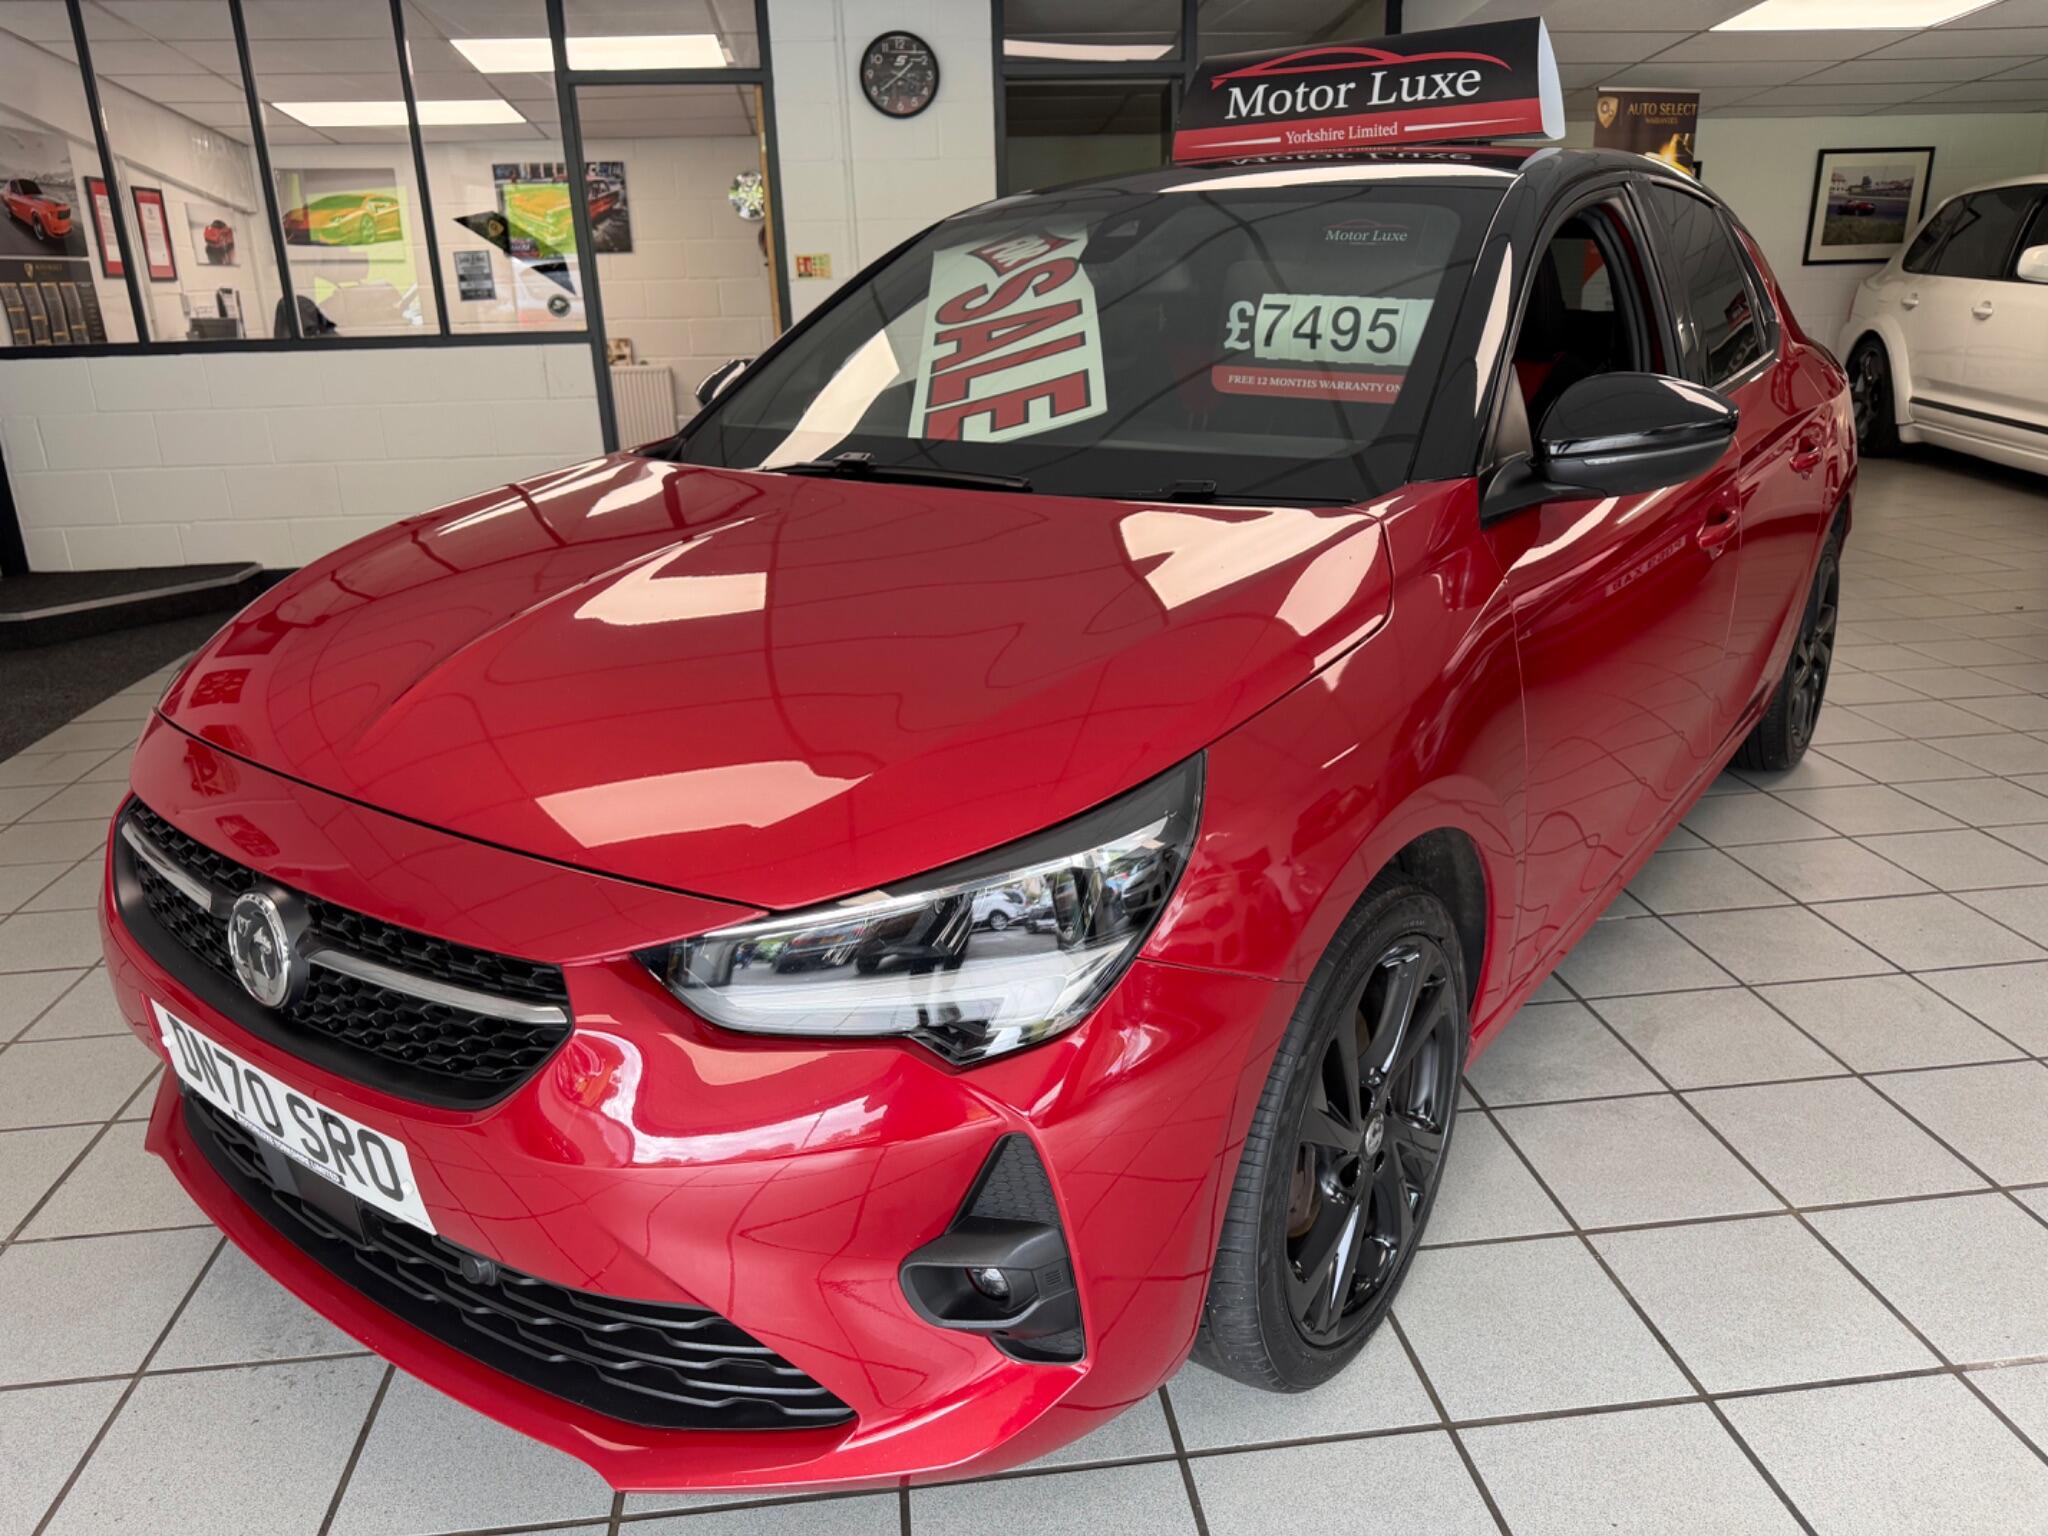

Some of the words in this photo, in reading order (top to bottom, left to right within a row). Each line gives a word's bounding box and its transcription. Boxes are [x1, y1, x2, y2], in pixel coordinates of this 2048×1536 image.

[1224, 82, 1356, 119] Motor
[1366, 70, 1481, 106] Luxe
[1627, 102, 1657, 116] AUTO
[1659, 102, 1698, 116] SELECT
[1285, 126, 1345, 145] Yorkshire
[1348, 121, 1398, 139] Limited
[1325, 229, 1370, 241] Motor
[1372, 229, 1408, 242] Luxe
[1223, 300, 1400, 354] £7495
[922, 257, 1091, 441] SALE
[1227, 374, 1256, 385] FREE
[1257, 376, 1268, 385] 12
[1269, 376, 1318, 389] MONTHS
[1319, 379, 1384, 392] WARRANTY
[166, 1013, 285, 1138] DN70
[286, 1092, 404, 1203] SRO
